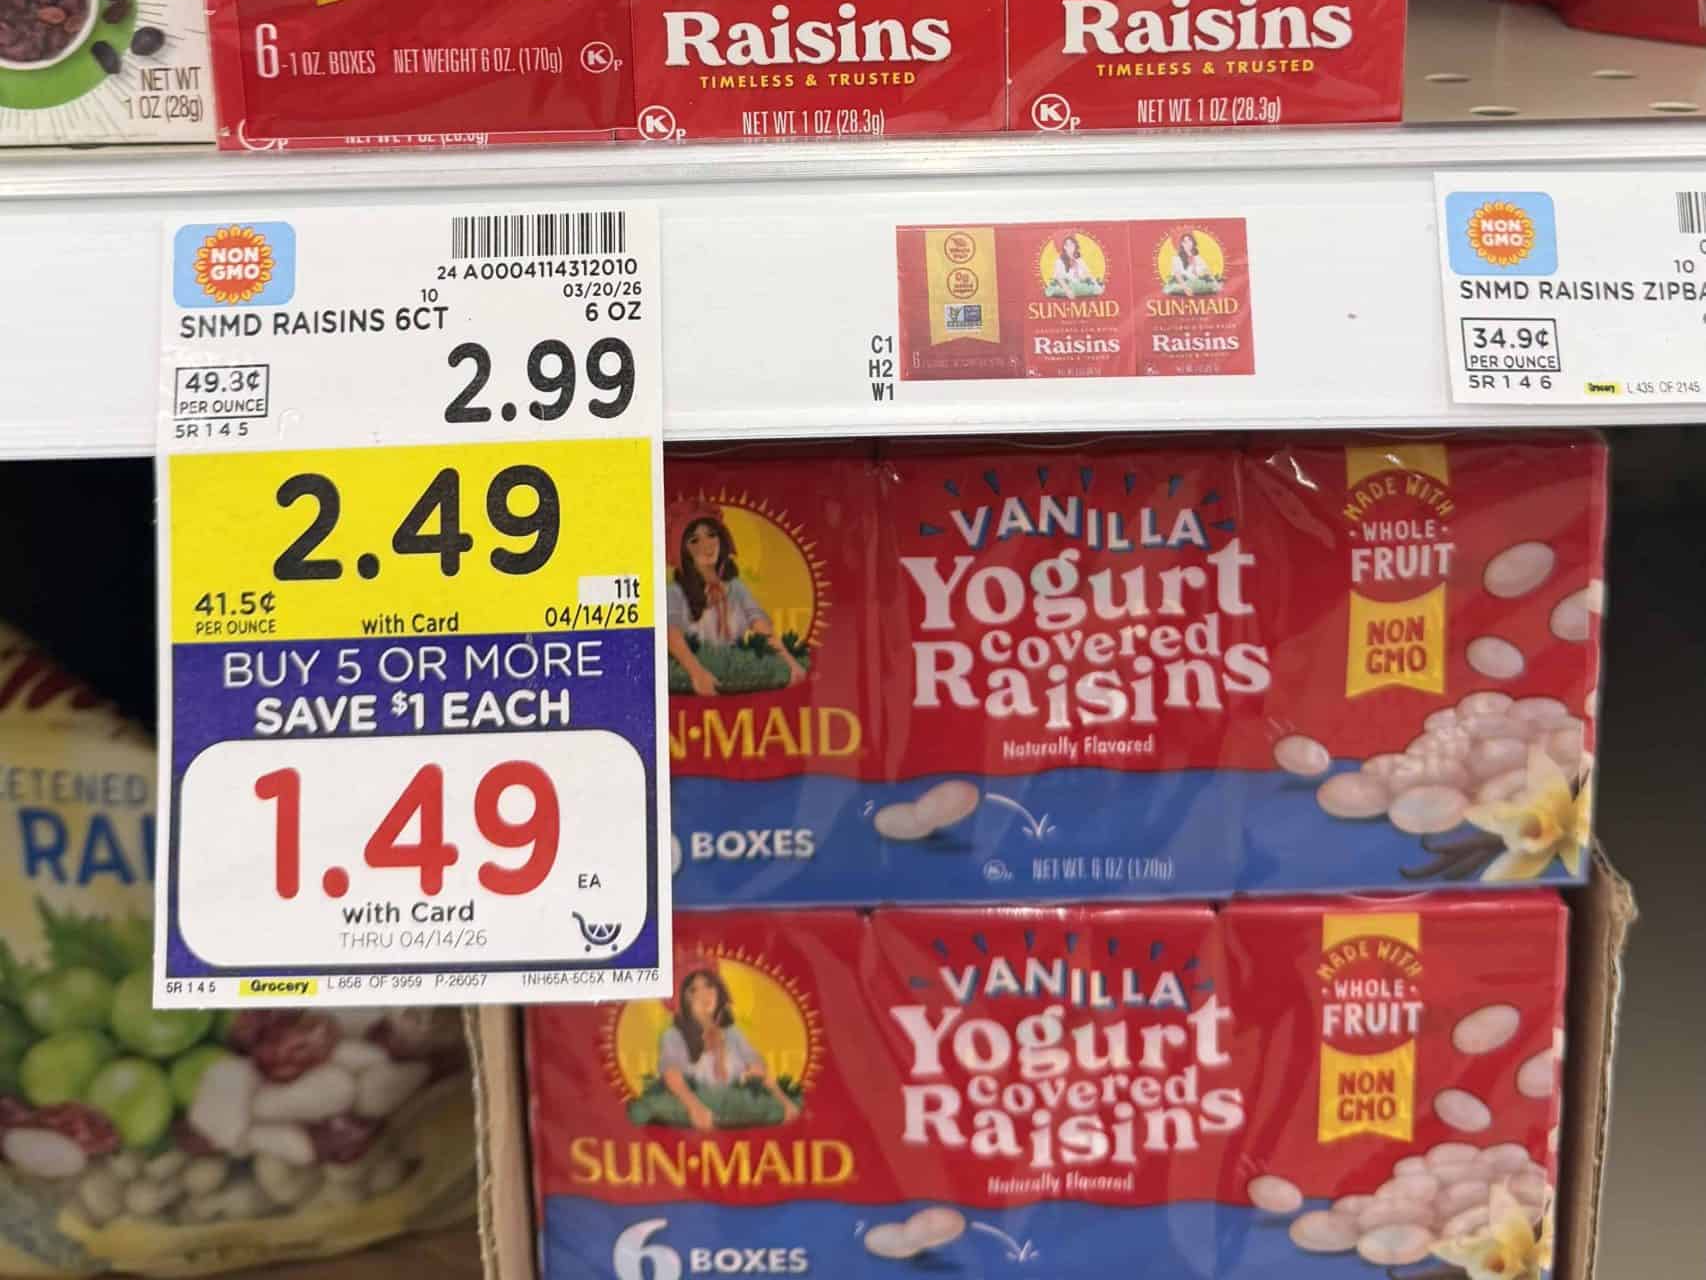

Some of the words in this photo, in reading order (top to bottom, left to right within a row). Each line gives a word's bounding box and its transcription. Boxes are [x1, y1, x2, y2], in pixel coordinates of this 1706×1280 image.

[663, 3, 952, 67] Raisins
[328, 50, 376, 75] BOXES
[393, 49, 418, 74] NET
[422, 48, 477, 74] WEIGHT
[1096, 62, 1192, 77] TIMELESS
[1227, 59, 1315, 74] TRUSTED
[141, 67, 171, 91] NET
[700, 74, 794, 89] TIMELESS
[828, 72, 915, 87] TRUSTED
[836, 109, 885, 135] (28.3g)
[1137, 99, 1163, 123] NET
[1232, 96, 1280, 123] (28.3g)
[1482, 233, 1524, 246] GMO
[211, 247, 260, 263] NON
[210, 264, 260, 281] GMO
[563, 281, 642, 298] 03/20/26
[1460, 280, 1529, 300] SNMD
[1539, 281, 1634, 301] RAISINS
[179, 313, 262, 339] SNMD
[273, 309, 385, 335] RAISINS
[395, 306, 449, 330] 6CT
[608, 301, 641, 321] OZ
[871, 335, 893, 354] C1
[1034, 334, 1120, 354] Raisins
[1152, 331, 1239, 352] Raisins
[1473, 327, 1549, 349] 34.9¢
[869, 359, 893, 378] H2
[1470, 356, 1499, 368] PER
[1503, 355, 1556, 369] OUNCE
[185, 370, 261, 393] 49.3¢
[444, 337, 635, 423] 2.99
[872, 383, 894, 401] W1
[179, 400, 207, 415] PER
[212, 398, 264, 414] OUNCE
[1344, 475, 1397, 520] MADE
[1404, 474, 1455, 516] WITH
[273, 464, 561, 581] 2.49
[950, 495, 1207, 550] VANILLA
[1363, 520, 1435, 540] WHOLE
[1351, 542, 1455, 583] FRUIT
[900, 537, 1256, 630] Yogurt
[194, 589, 276, 618] 41.5¢
[195, 620, 225, 635] PER
[228, 618, 276, 634] OUNCE
[362, 615, 405, 634] with
[412, 612, 459, 633] Card
[545, 603, 639, 631] 04/14/26
[981, 614, 1221, 669] covered
[1366, 616, 1424, 646] NON
[224, 649, 321, 689] BUY
[337, 649, 361, 686] 5
[379, 646, 447, 684] OR
[465, 641, 603, 681] MORE
[1366, 645, 1427, 674] GMO
[912, 641, 1271, 730] Raisins
[254, 695, 377, 737] SAVE
[392, 690, 425, 730] $1
[443, 688, 571, 729] EACH
[1003, 734, 1079, 760] Naturally
[1084, 733, 1153, 754] Flavored
[254, 759, 561, 900] 1.49
[690, 828, 815, 861] BOXES
[578, 873, 601, 889] EA
[343, 901, 400, 924] with
[411, 900, 475, 923] Card
[339, 930, 393, 950] THRU
[400, 928, 488, 950] 04/14/26
[1317, 940, 1369, 981] MADE
[1377, 941, 1424, 977] WITH
[250, 979, 309, 994] Grocery
[392, 974, 422, 988] 3959
[638, 968, 659, 983] 776
[940, 957, 1189, 1008] VANILLA
[1334, 978, 1404, 999] WHOLE
[1322, 1001, 1424, 1037] FRUIT
[890, 995, 1231, 1077] Yogurt
[970, 1065, 1199, 1115] covered
[1338, 1070, 1395, 1096] NON
[1337, 1096, 1396, 1122] GMO
[901, 1084, 1244, 1168] Raisins
[690, 1246, 808, 1274] BOXES
